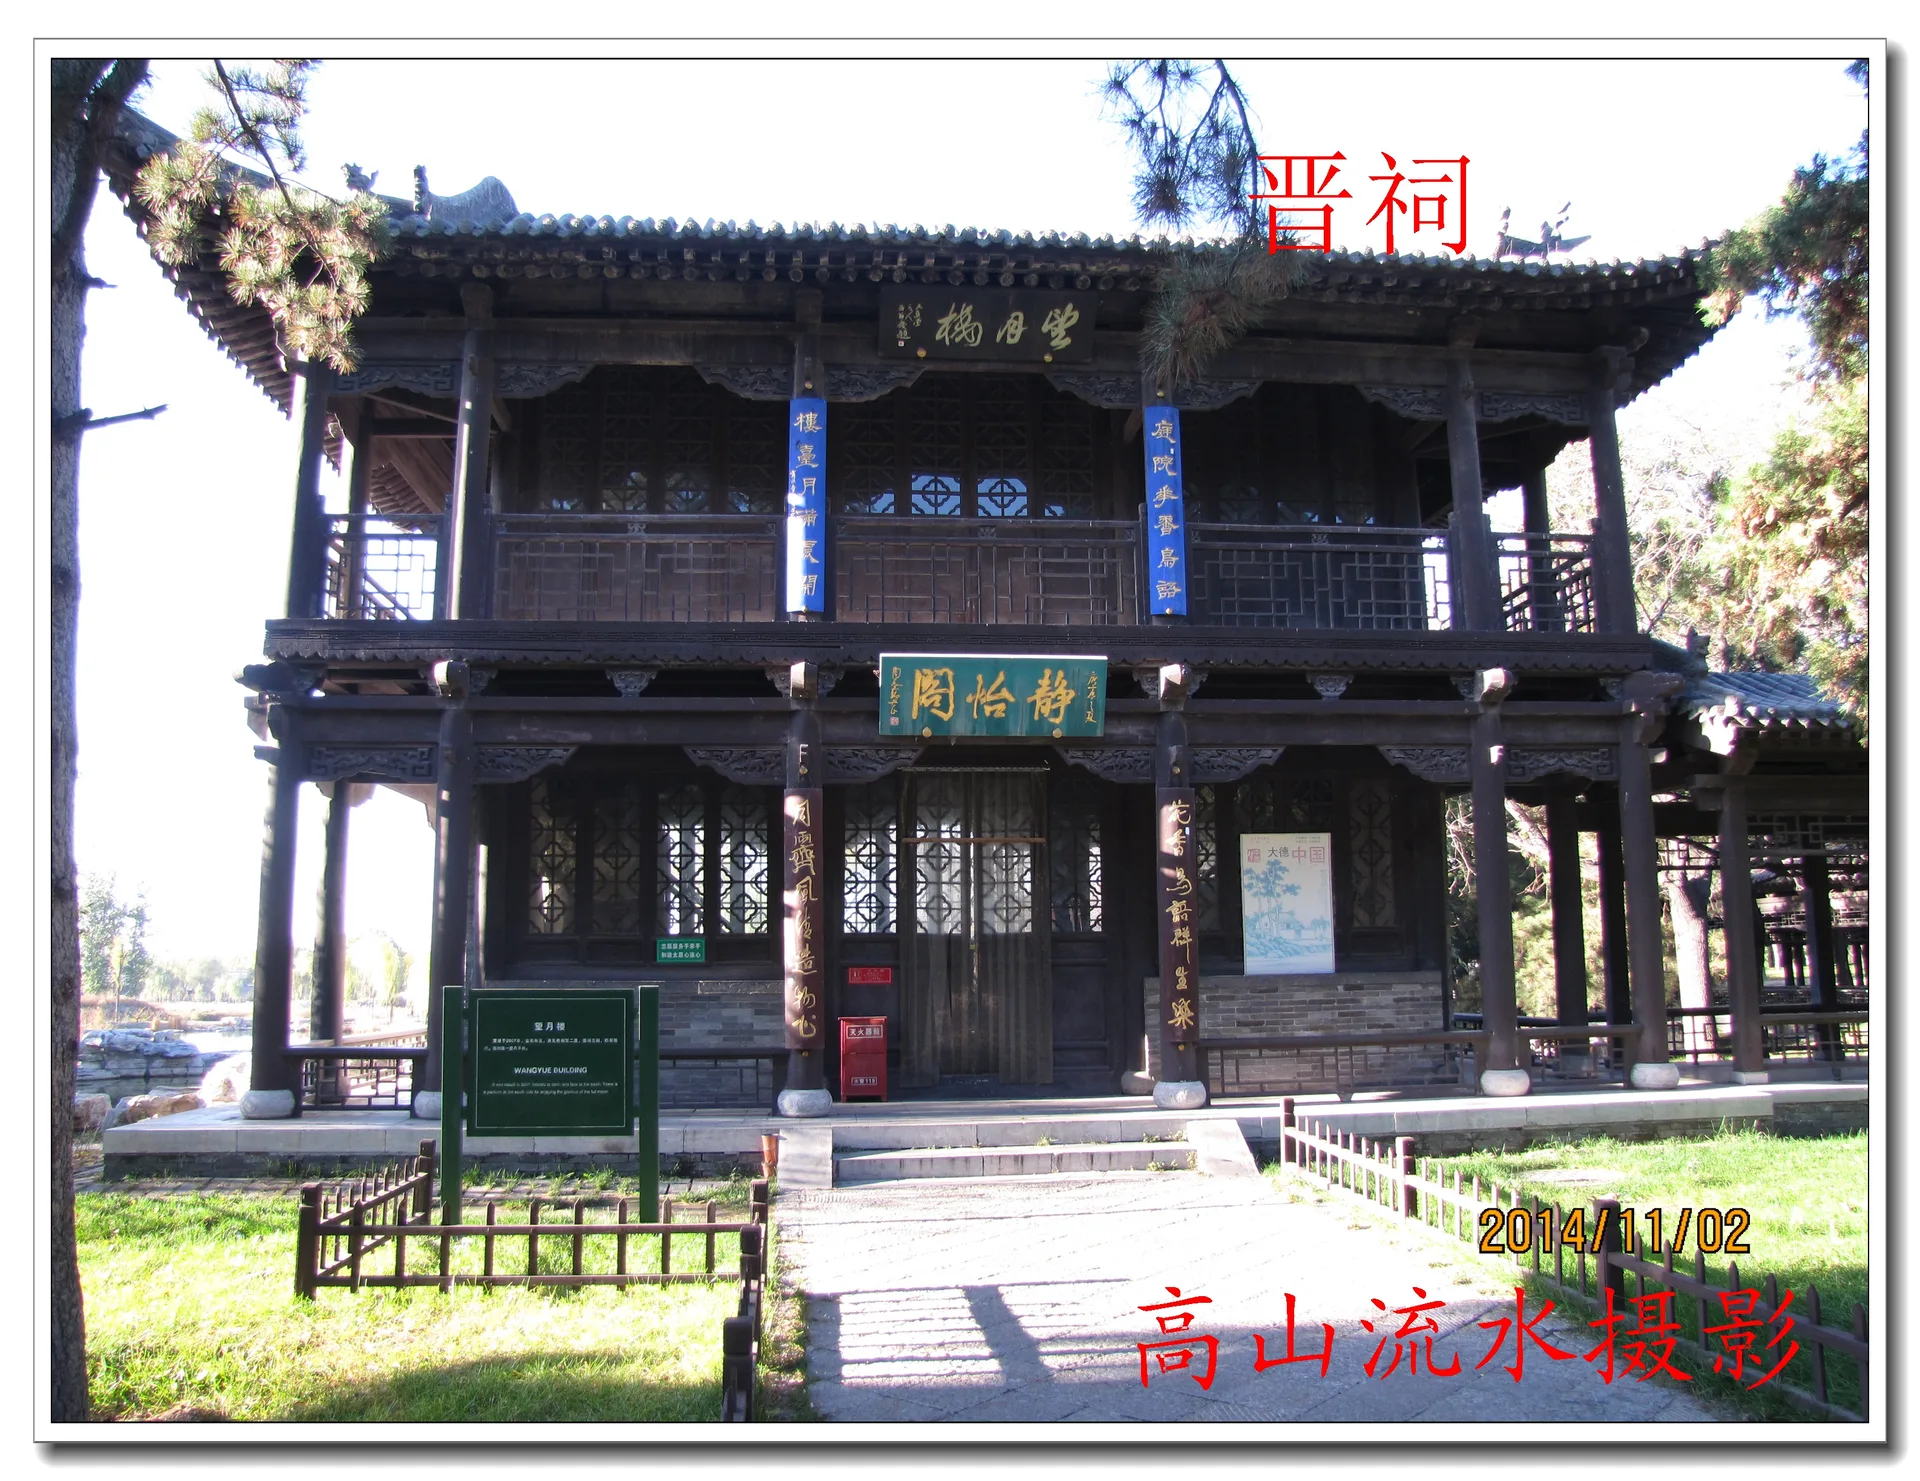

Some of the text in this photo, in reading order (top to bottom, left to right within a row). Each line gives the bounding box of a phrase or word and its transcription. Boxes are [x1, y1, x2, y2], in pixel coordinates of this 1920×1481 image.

[534, 1021, 566, 1031] 望月楼
[514, 1066, 588, 1074] WANGYUE BUILDING
